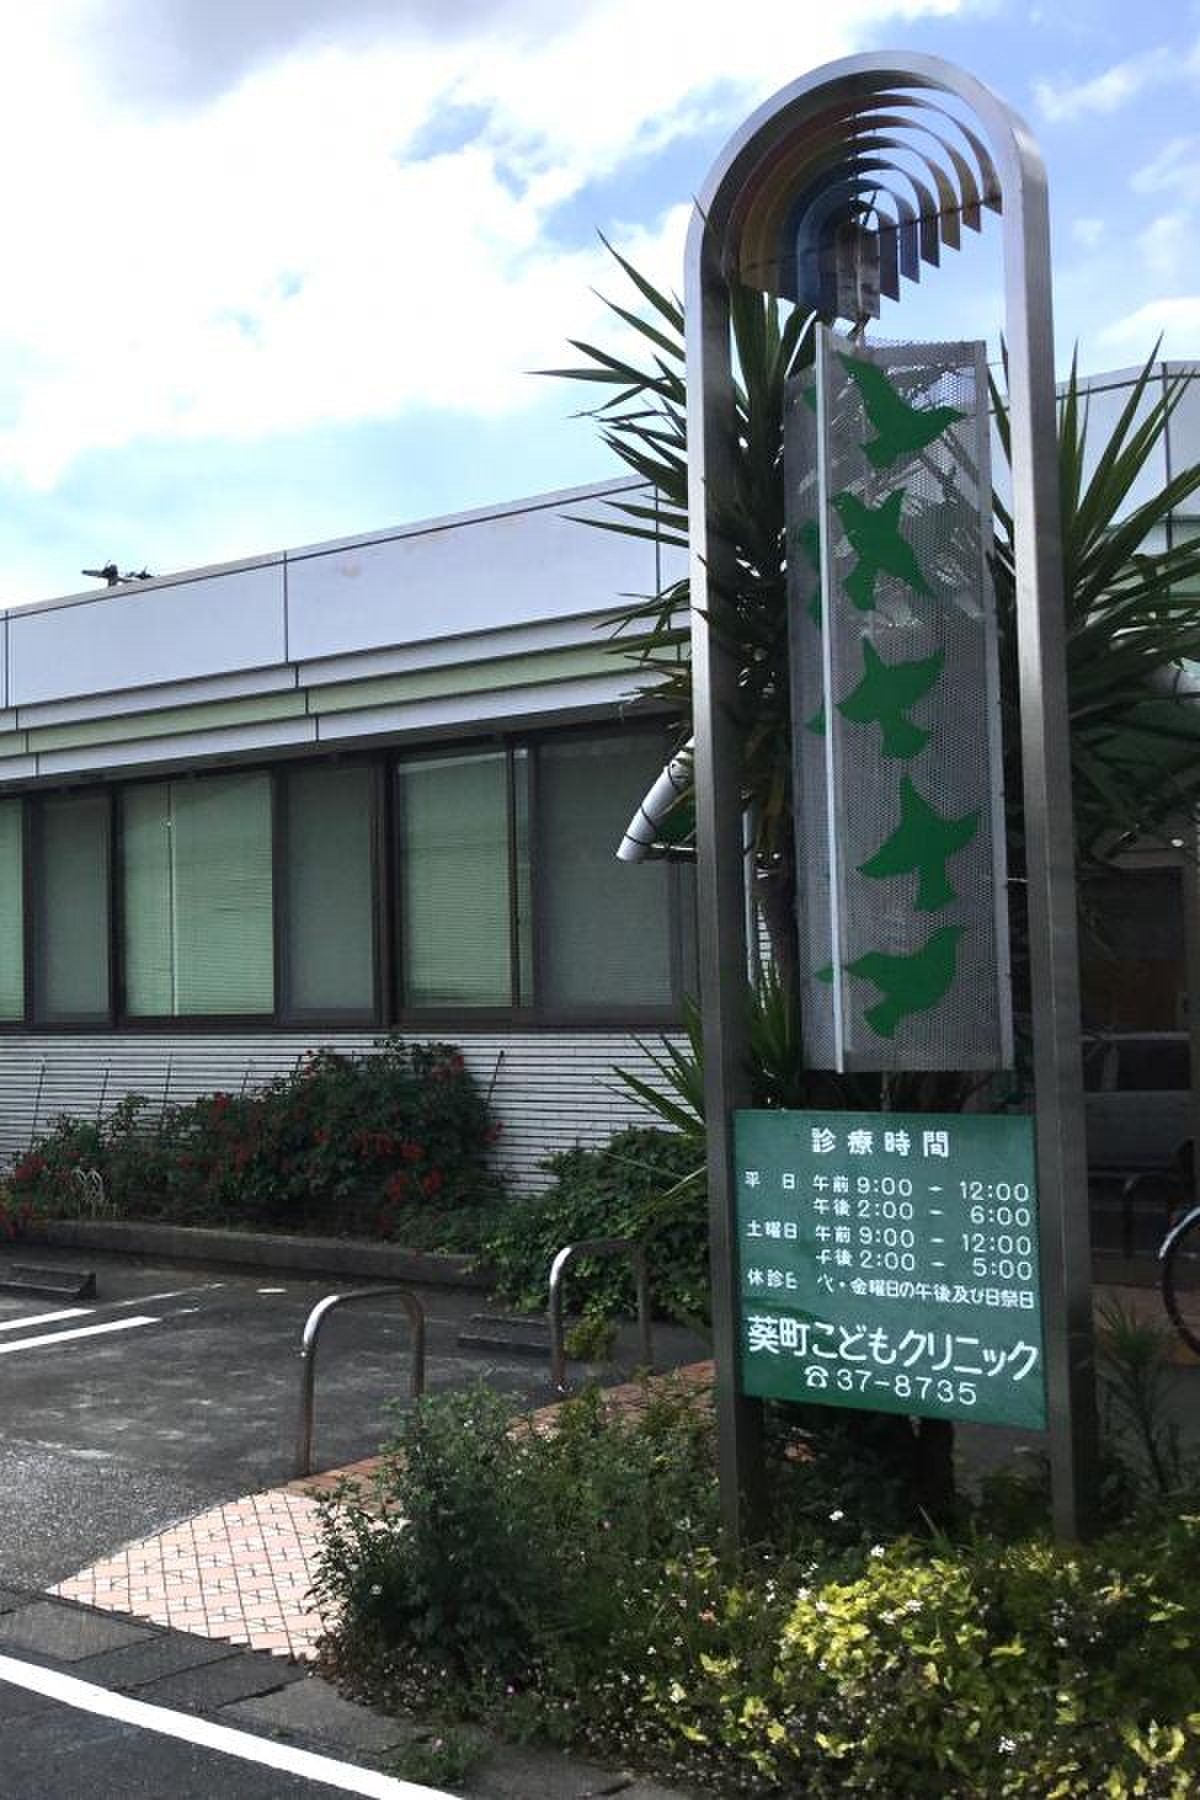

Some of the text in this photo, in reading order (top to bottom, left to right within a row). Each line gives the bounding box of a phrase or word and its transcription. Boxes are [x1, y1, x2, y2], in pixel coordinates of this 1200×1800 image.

[812, 1128, 948, 1157] 診療時間
[813, 1175, 848, 1192] 午前
[858, 1177, 912, 1196] 9:00
[960, 1182, 1028, 1201] 12:00
[814, 1198, 850, 1216] 午後
[858, 1200, 912, 1219] 2:00
[971, 1206, 1030, 1226] 6:00
[747, 1221, 797, 1238] 土曜日
[816, 1225, 850, 1243] 午前
[859, 1227, 914, 1248] 9:00
[963, 1233, 1030, 1255] 12:00
[816, 1249, 852, 1266] 午後
[860, 1250, 914, 1271] 2:00
[973, 1258, 1032, 1280] 5:00
[748, 1316, 1038, 1381] 葵町こどもクリニック
[837, 1369, 978, 1405] 37-8735
